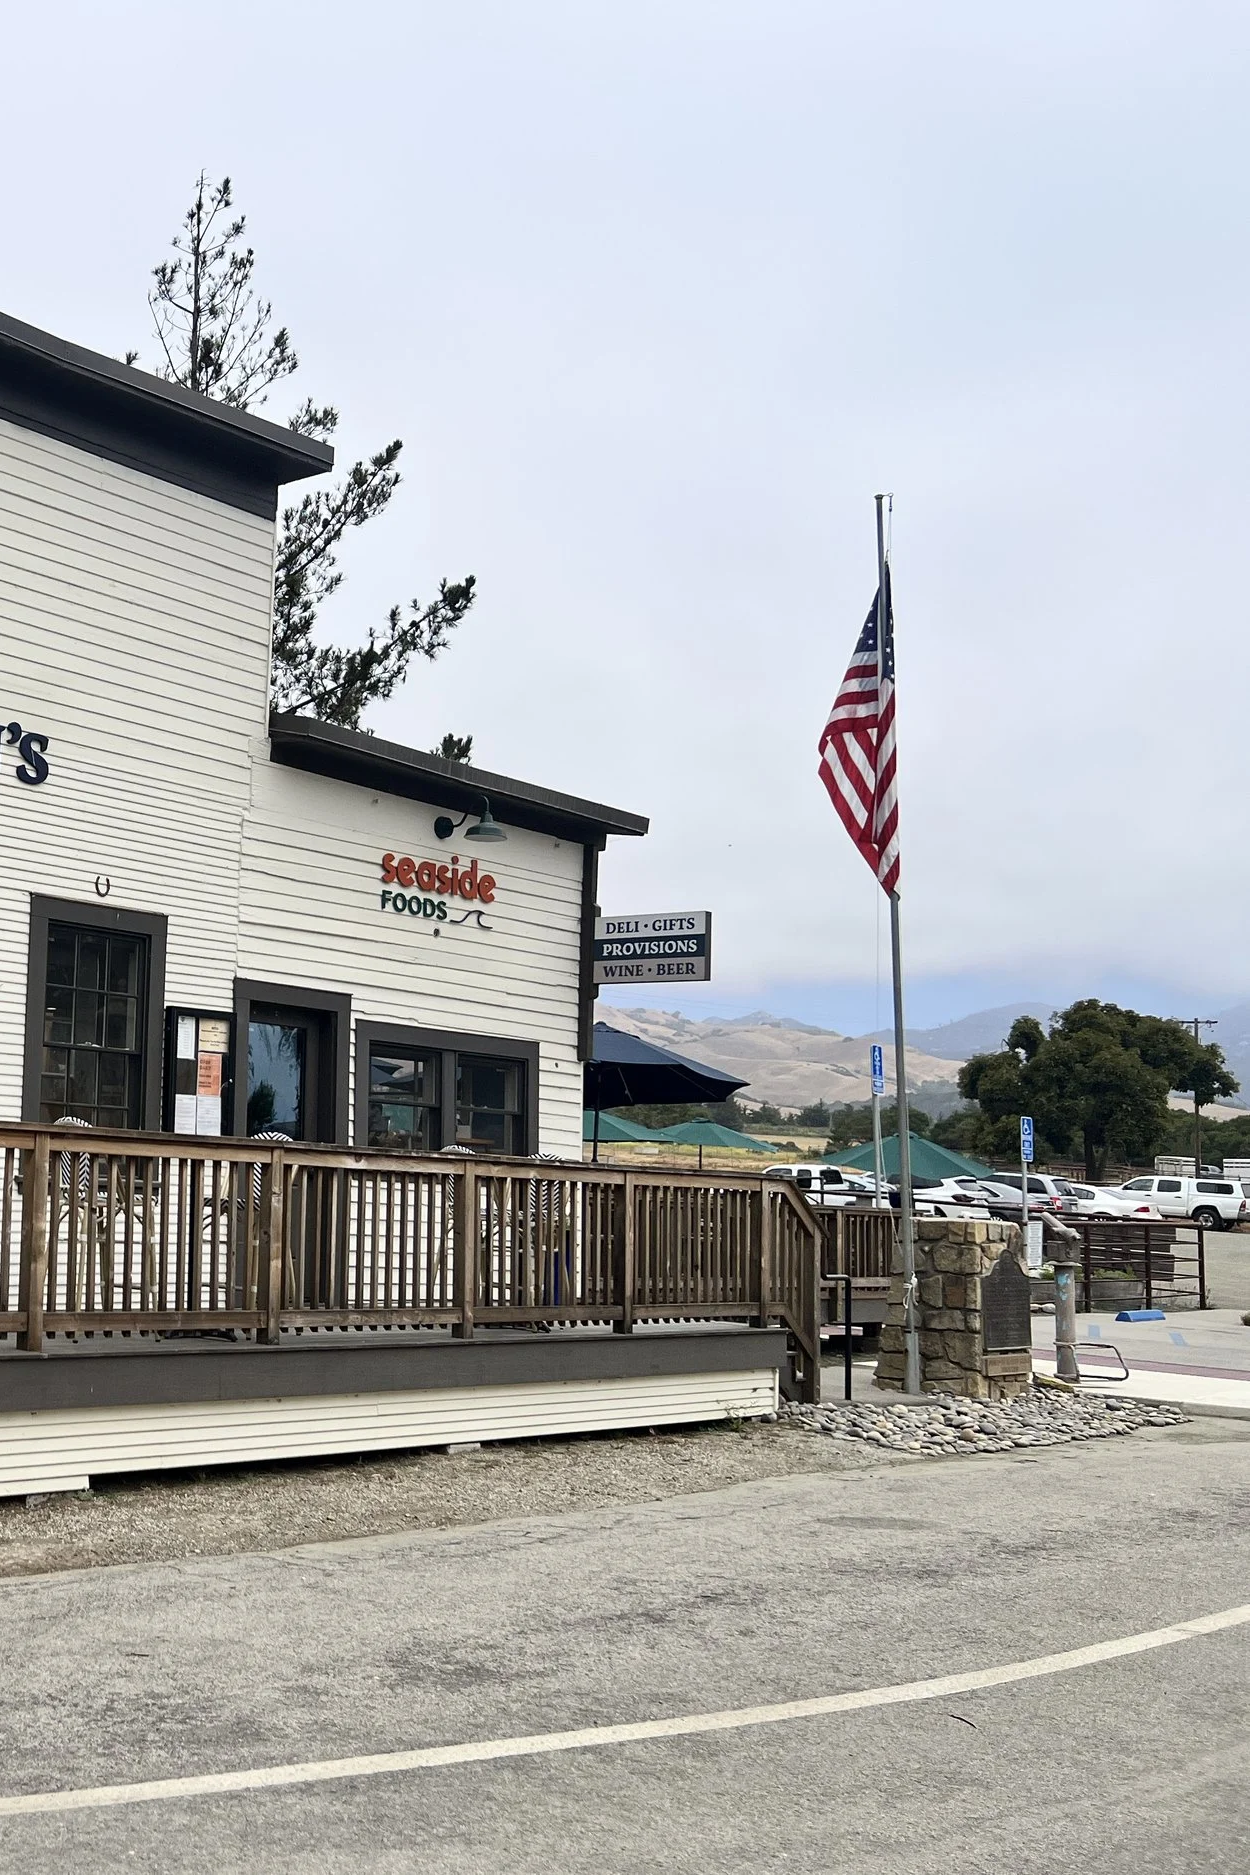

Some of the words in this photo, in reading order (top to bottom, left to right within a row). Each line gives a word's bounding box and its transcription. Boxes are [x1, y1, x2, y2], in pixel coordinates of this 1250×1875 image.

[381, 853, 496, 904] seaside
[381, 890, 448, 920] FOODS
[605, 921, 640, 935] DELI
[652, 917, 695, 932] GIFTS
[602, 939, 698, 957] PROVISIONS
[603, 965, 644, 978] WINE
[656, 962, 696, 976] BEER
